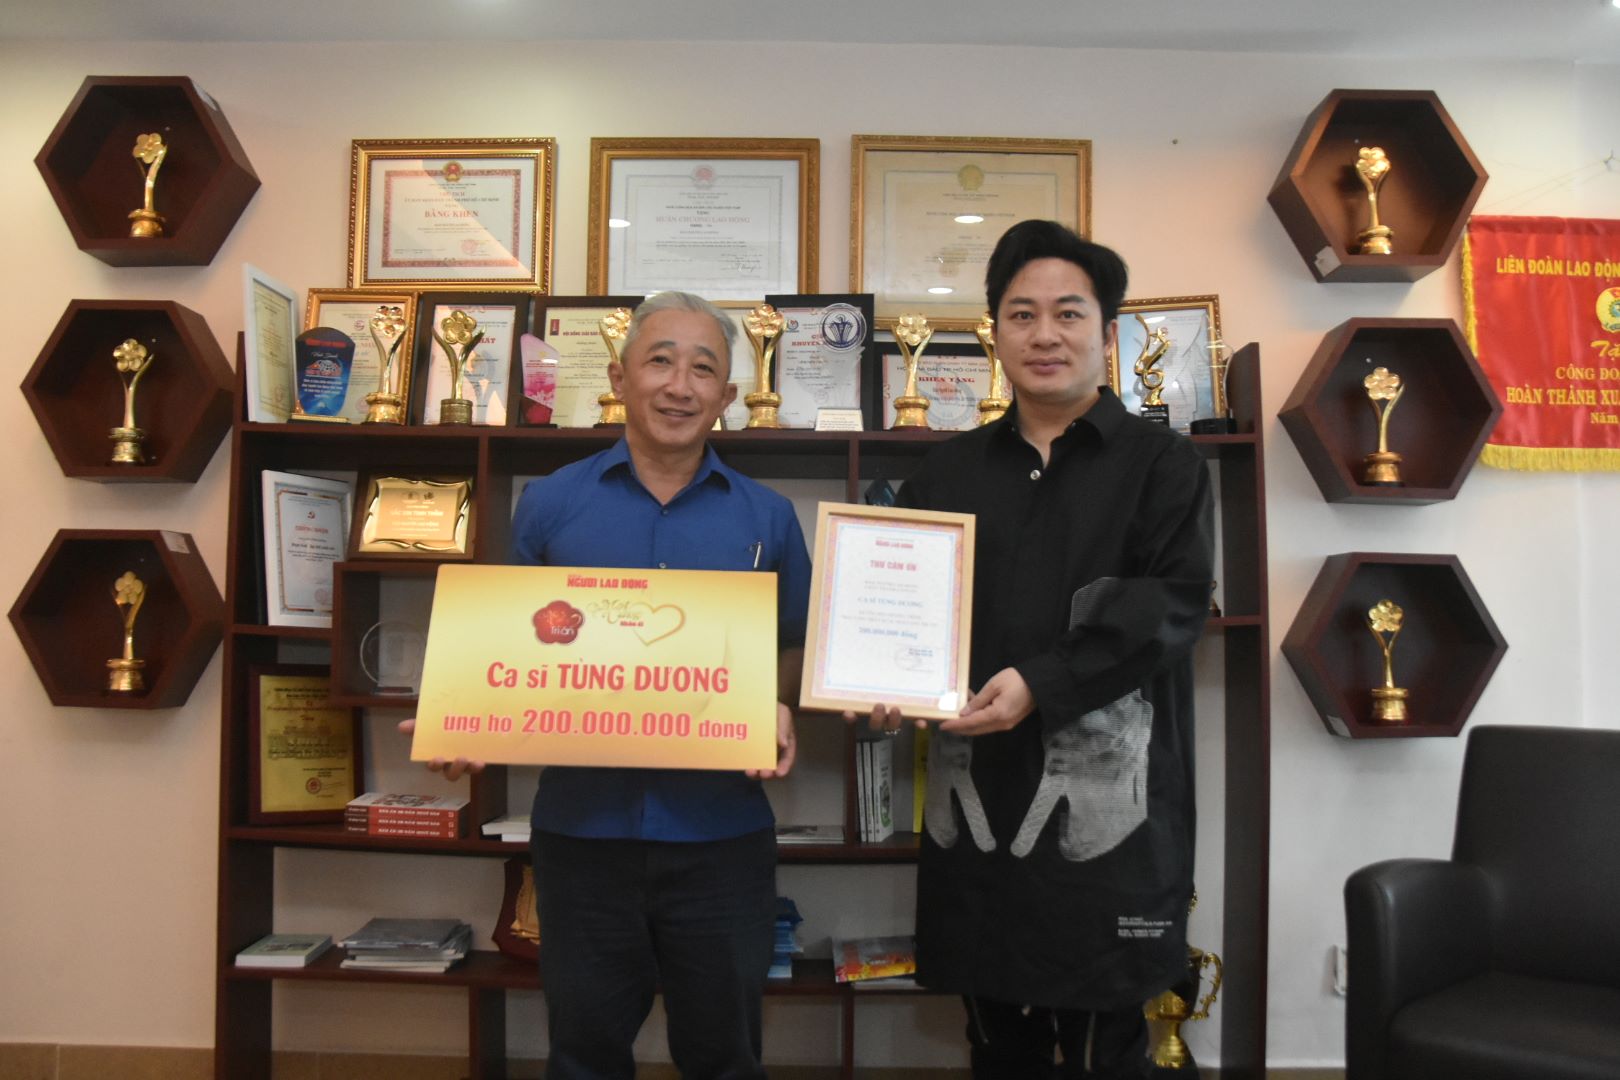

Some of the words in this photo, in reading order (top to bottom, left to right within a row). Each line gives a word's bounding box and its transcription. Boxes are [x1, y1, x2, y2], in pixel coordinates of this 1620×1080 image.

[1496, 255, 1525, 274] LIÊN
[1527, 255, 1564, 275] ĐOÀN
[1566, 259, 1591, 276] LAO
[1555, 363, 1596, 380] CÔNG
[1600, 367, 1620, 380] ĐO
[1506, 383, 1543, 405] HOÀN
[1546, 384, 1597, 406] THÀNH
[1600, 388, 1620, 405] XU
[1590, 411, 1619, 424] Năm
[486, 661, 519, 689] Ca
[526, 664, 549, 689] sĩ
[557, 657, 625, 692] TÙNG
[633, 664, 730, 694] DƯƠNG
[521, 709, 692, 738] 200.000.000
